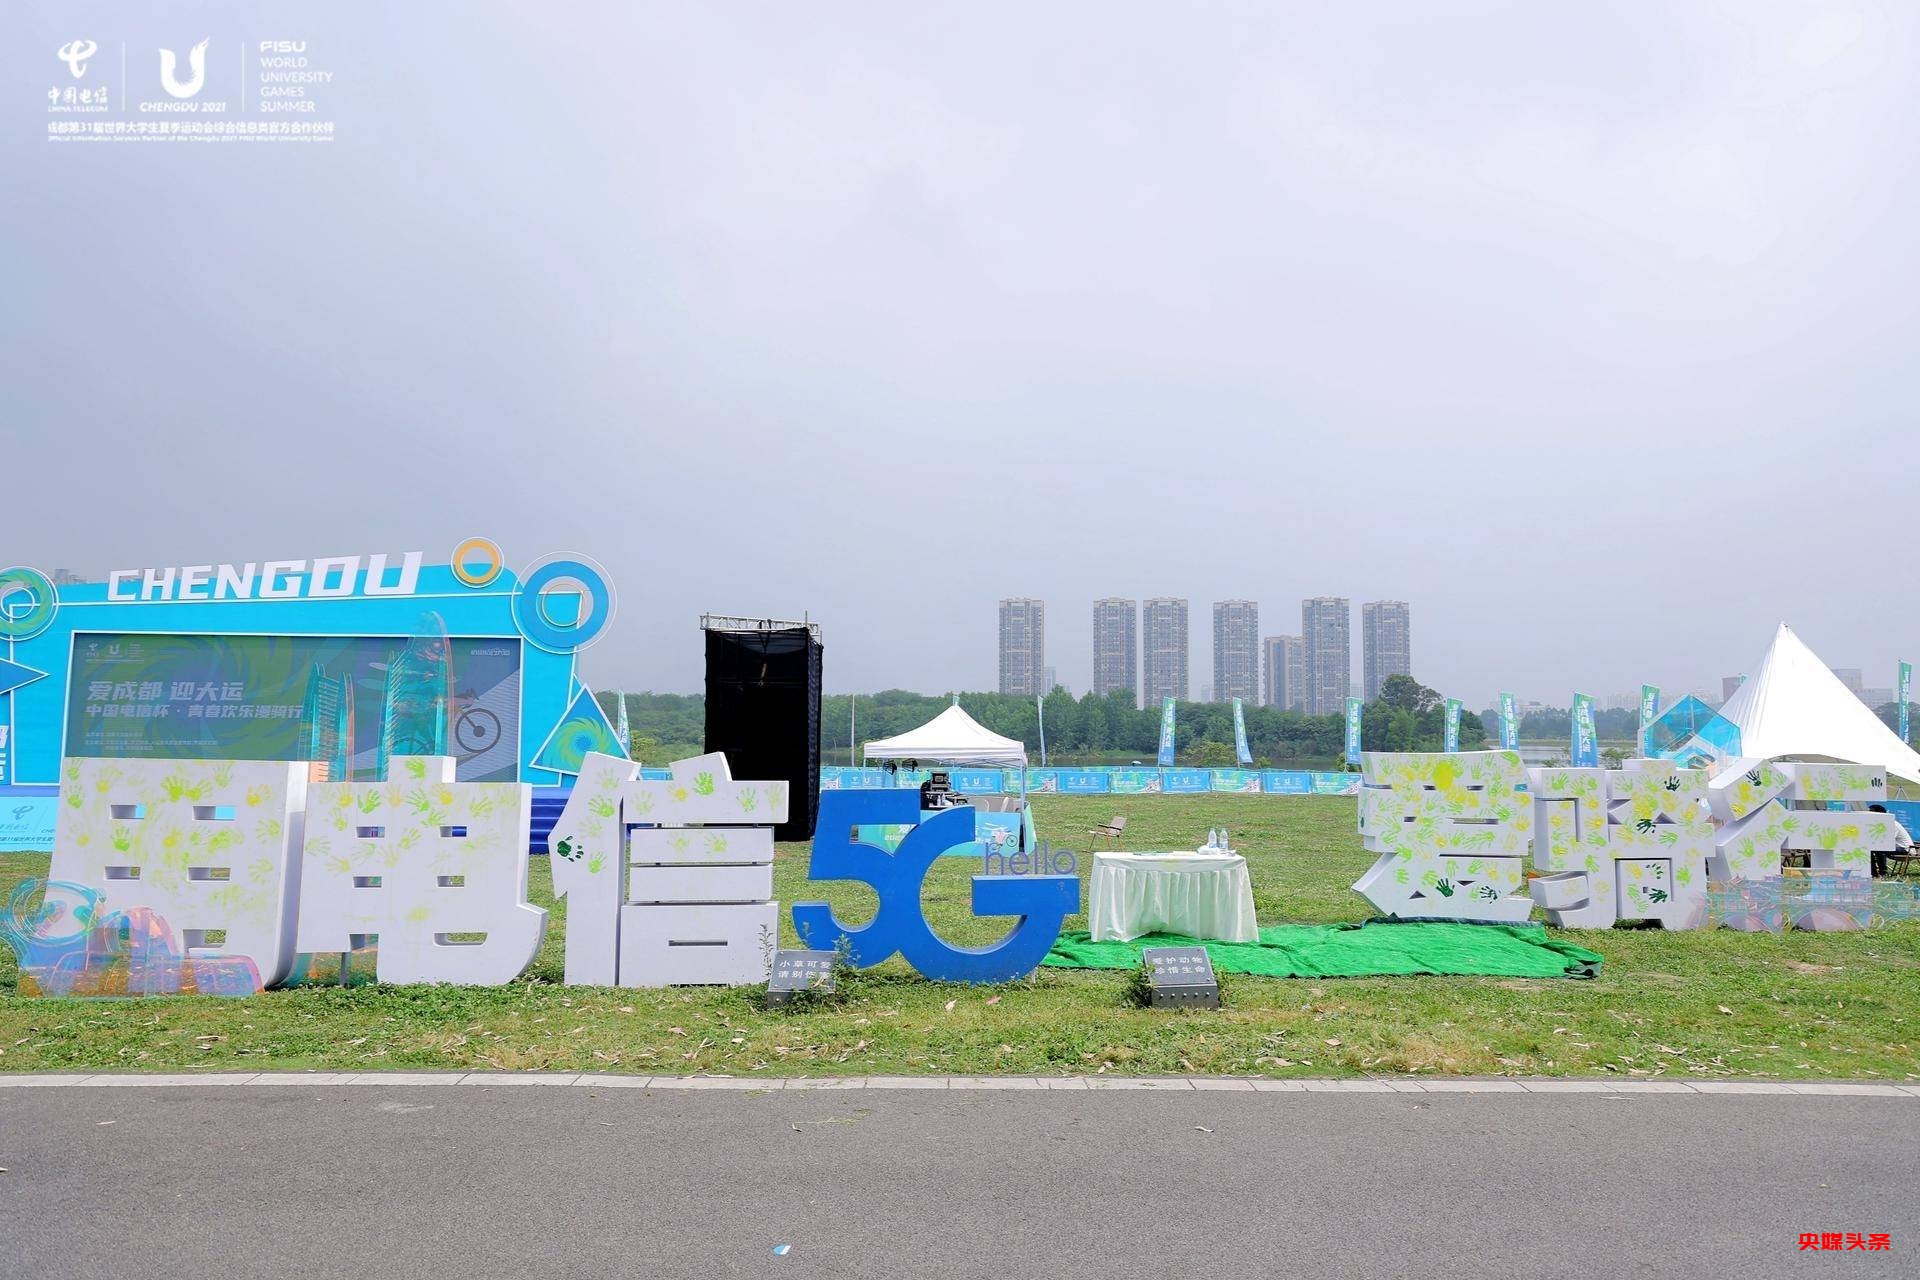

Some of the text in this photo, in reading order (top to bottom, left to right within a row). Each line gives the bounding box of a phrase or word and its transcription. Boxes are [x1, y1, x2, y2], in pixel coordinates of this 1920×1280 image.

[107, 551, 423, 601] CHENGDU
[88, 681, 244, 701] 爱成都 迎大运
[985, 841, 1077, 876] hello
